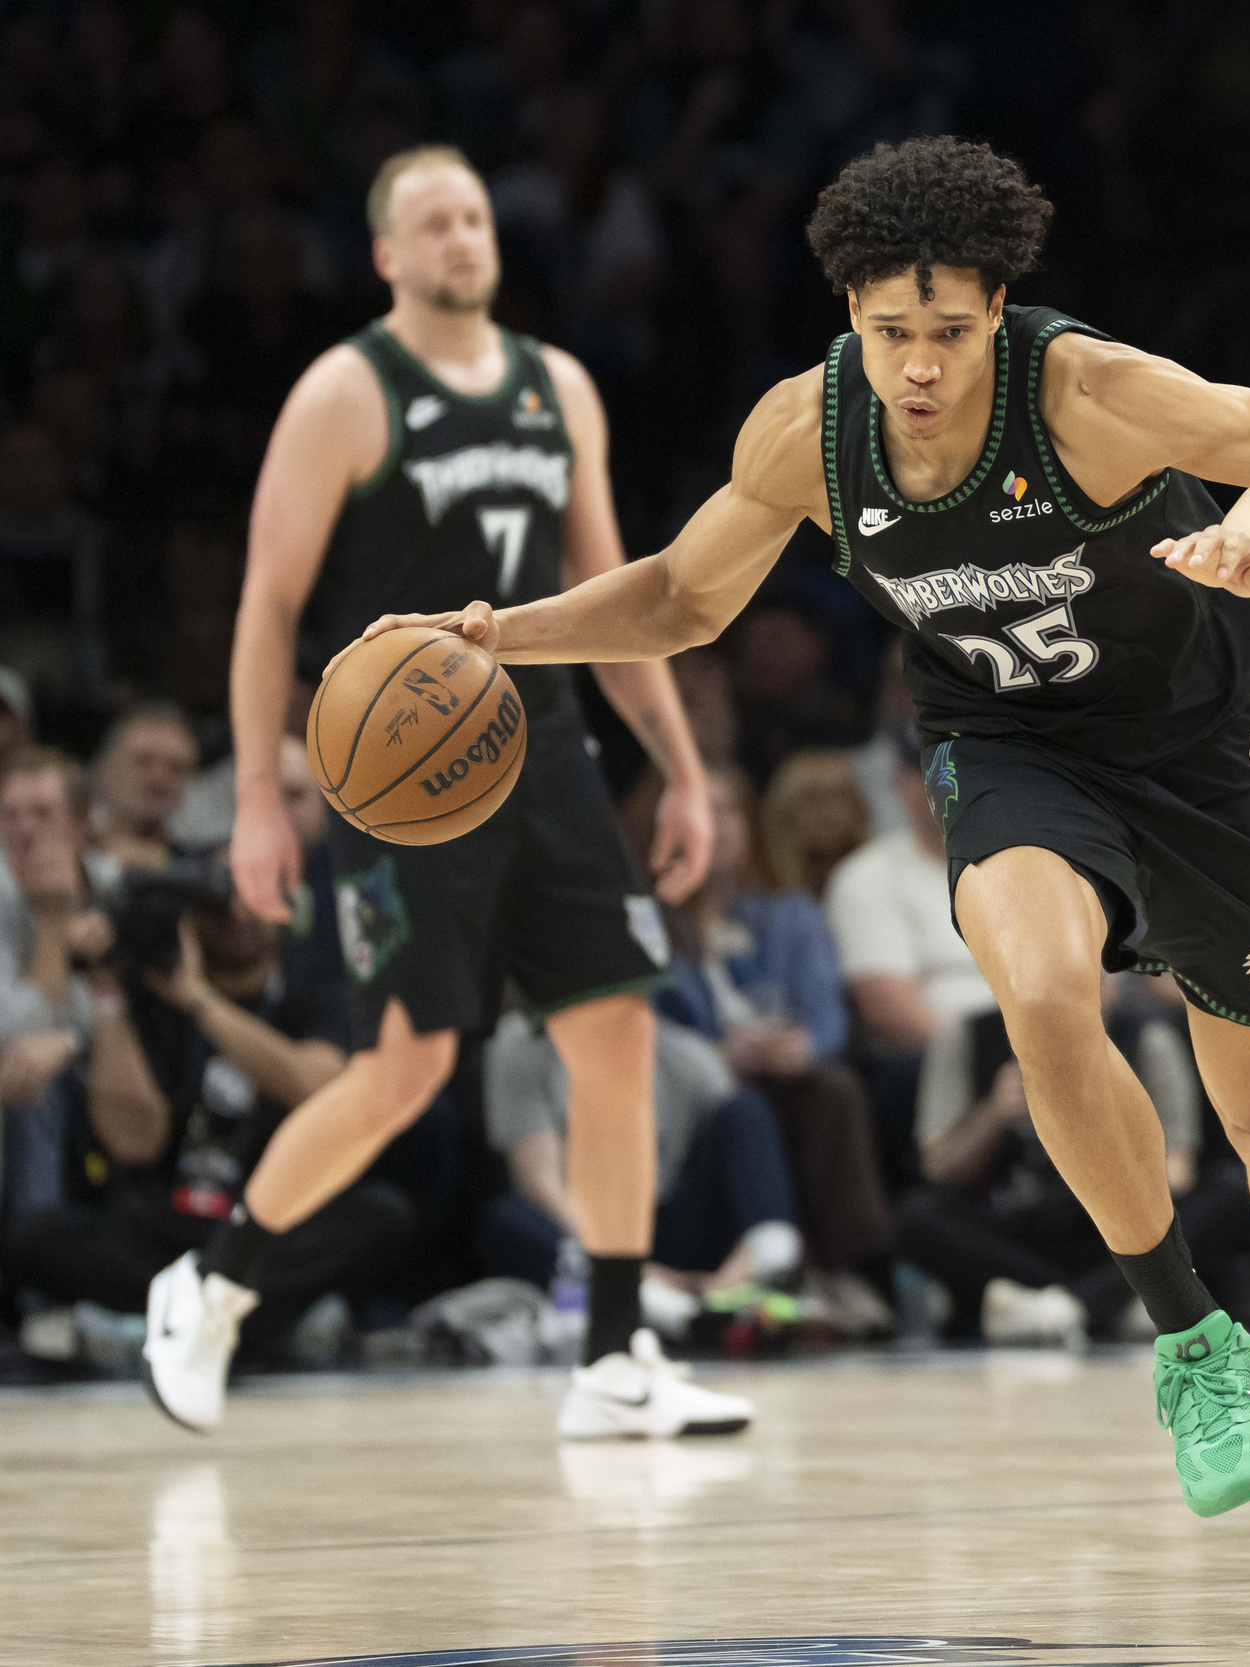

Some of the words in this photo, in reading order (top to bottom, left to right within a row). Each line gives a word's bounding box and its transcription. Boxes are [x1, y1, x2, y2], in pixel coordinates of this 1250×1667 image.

[479, 505, 530, 598] 7
[862, 507, 889, 526] NIKE
[989, 498, 1054, 524] sezzle
[863, 542, 1096, 631] TIMBERWOLVES
[938, 601, 1100, 694] 25
[417, 689, 522, 798] Wilson
